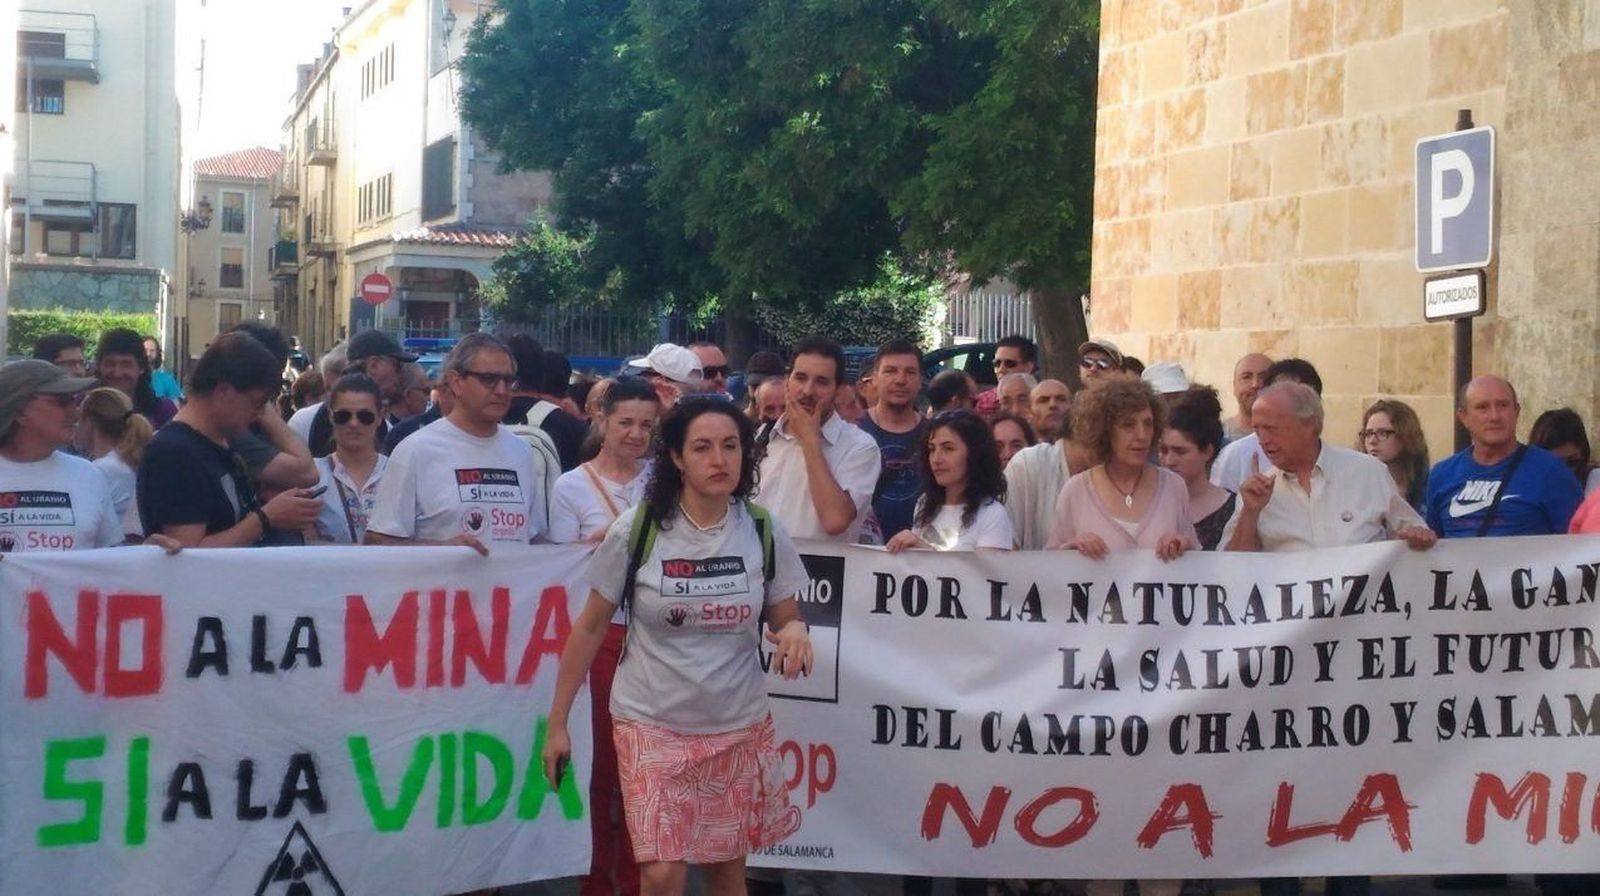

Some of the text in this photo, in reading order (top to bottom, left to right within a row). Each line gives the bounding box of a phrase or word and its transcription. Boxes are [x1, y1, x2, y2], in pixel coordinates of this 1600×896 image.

[1431, 149, 1475, 254] P
[1428, 285, 1478, 306] AUTORIZADOS
[20, 495, 32, 503] AL
[27, 513, 39, 521] LA
[40, 513, 62, 521] VIDA
[491, 507, 525, 530] Stop
[27, 530, 74, 552] Stop
[665, 561, 741, 577] NO AL URANIO
[870, 562, 1600, 626] POR LA NATURALEZA, LA GAN
[701, 602, 752, 624] Stop
[24, 585, 572, 699] NO A LA MINA
[1057, 626, 1600, 694] LA SALUD Y EL FUTUR
[871, 693, 1600, 757] DEL CAMPO CHARRO Y SALAM
[36, 713, 584, 848] SI A LA VIDA
[920, 781, 1101, 849] NO
[1136, 782, 1224, 860] A
[1265, 771, 1419, 853] LA
[764, 842, 777, 856] DE
[778, 843, 835, 859] SALAMANCA
